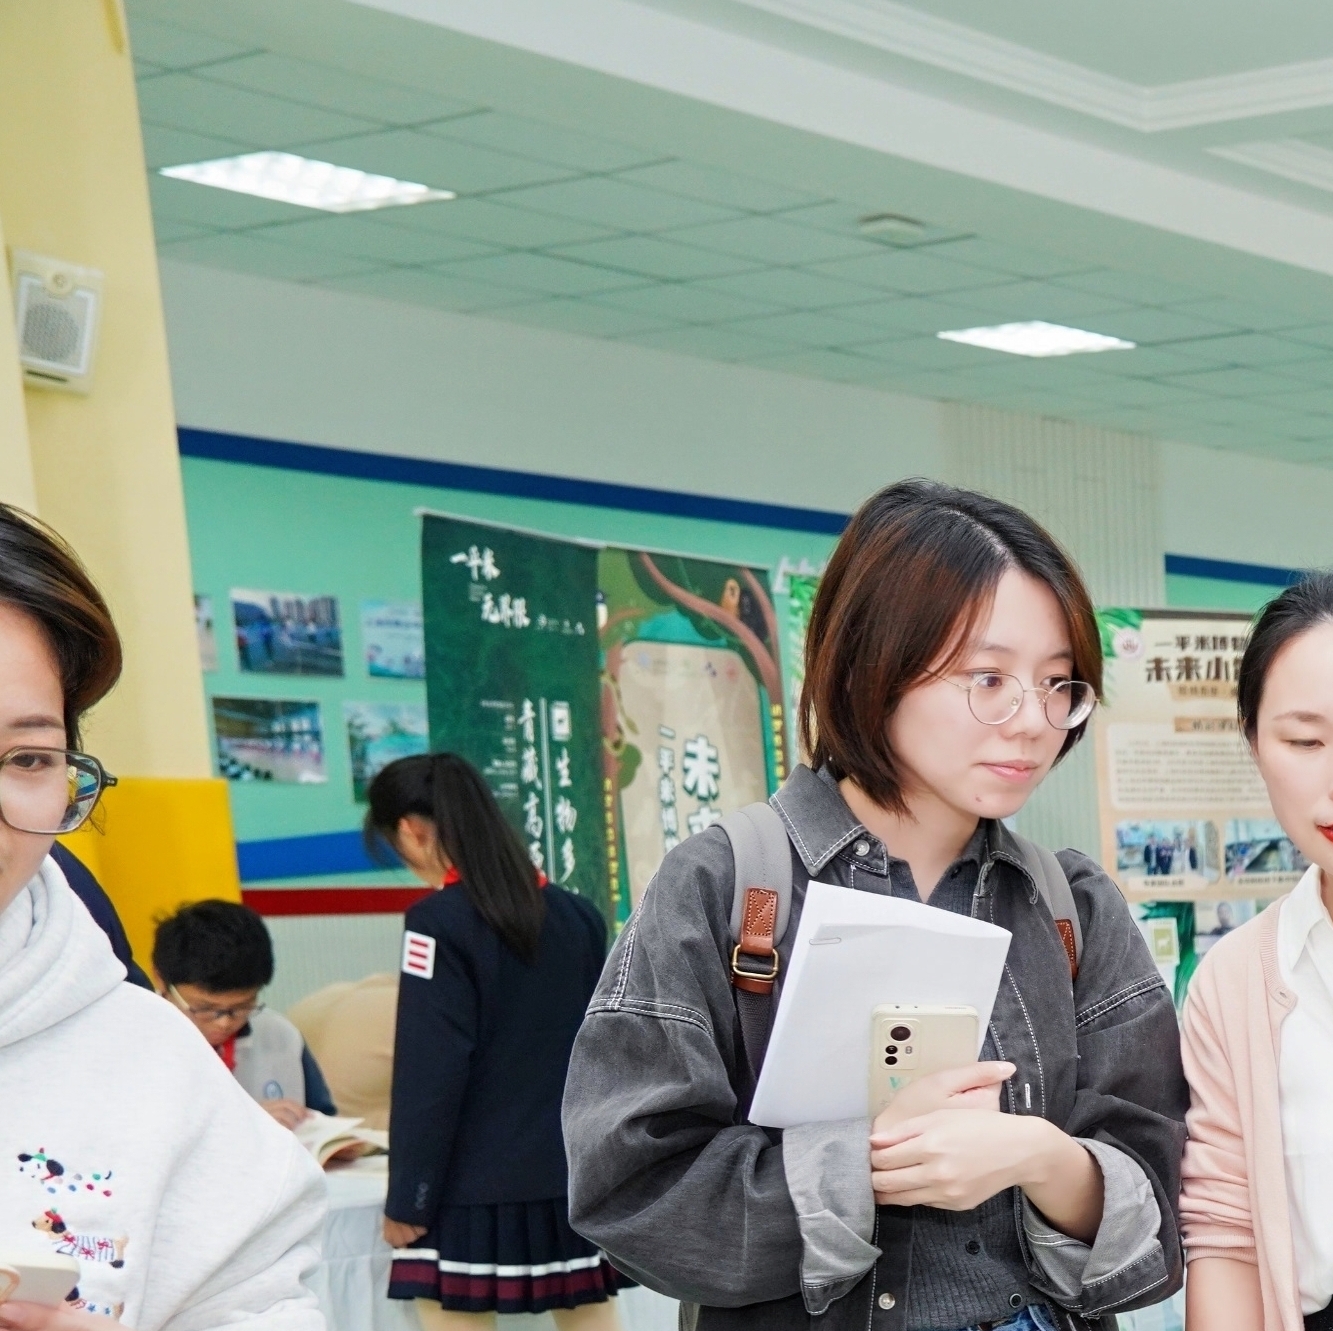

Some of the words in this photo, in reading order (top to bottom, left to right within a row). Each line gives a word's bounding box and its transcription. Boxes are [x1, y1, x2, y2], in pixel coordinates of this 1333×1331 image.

[449, 544, 501, 581] 一平米
[554, 746, 580, 895] 生物多
